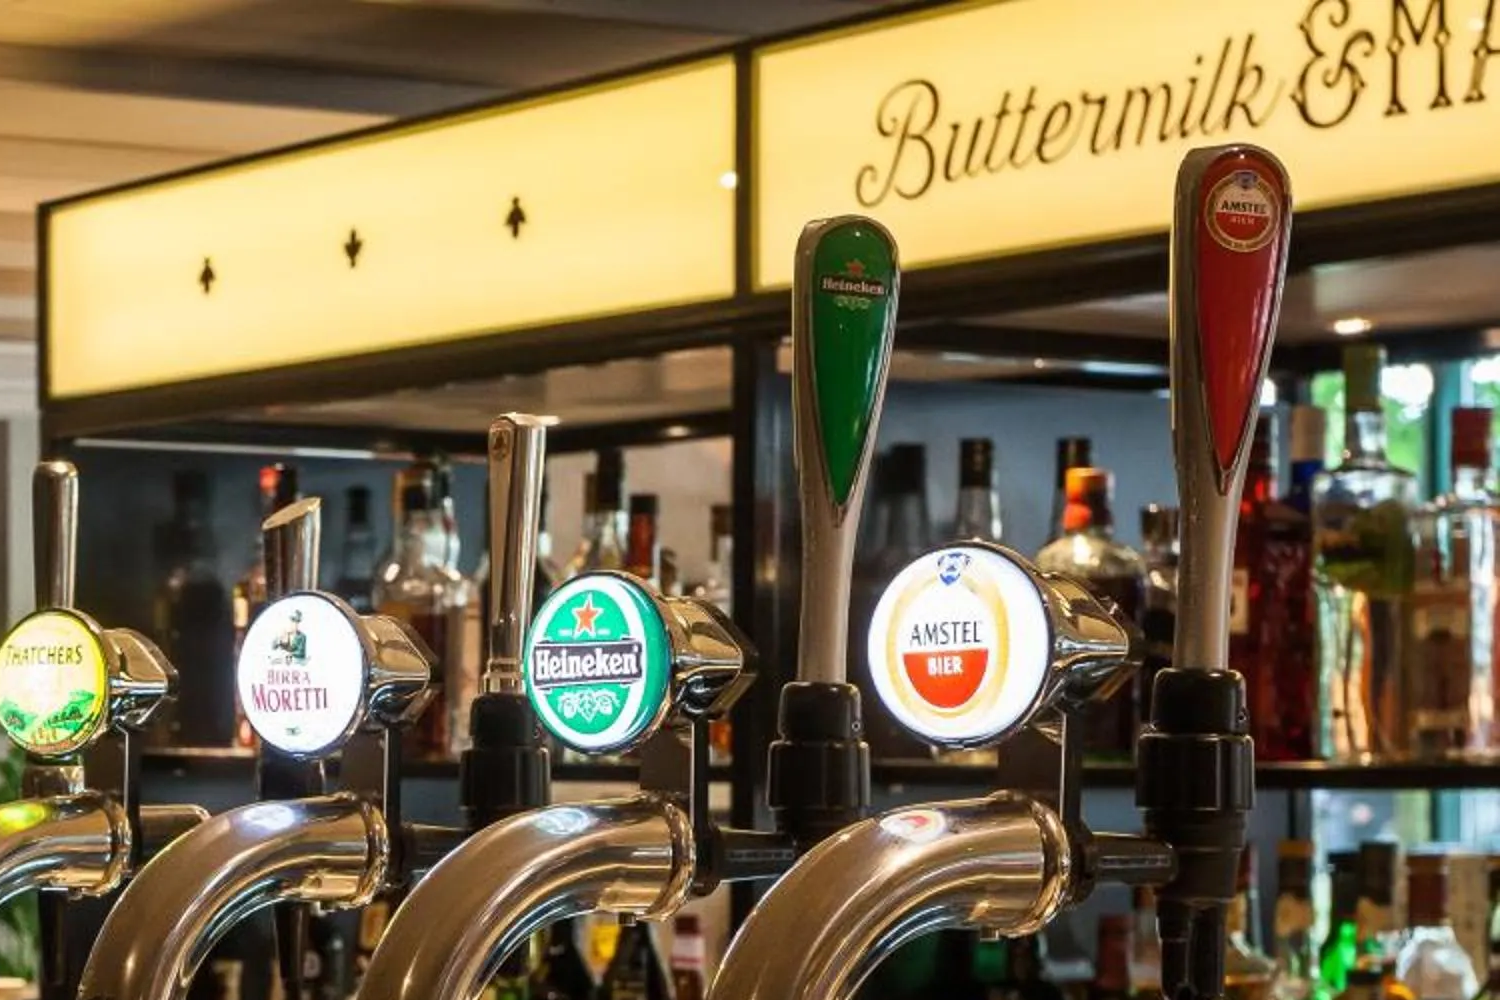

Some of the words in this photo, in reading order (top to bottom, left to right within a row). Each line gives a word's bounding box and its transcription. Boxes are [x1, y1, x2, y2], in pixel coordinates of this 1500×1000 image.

[855, 34, 1284, 207] Buttermilk
[822, 277, 885, 296] Heineken
[910, 620, 982, 646] AMSTEL
[5, 644, 84, 666] THATCHERS
[535, 646, 639, 681] Heineken
[927, 655, 963, 677] BIER
[267, 669, 311, 685] BIRRA
[251, 683, 328, 712] MORETTI
